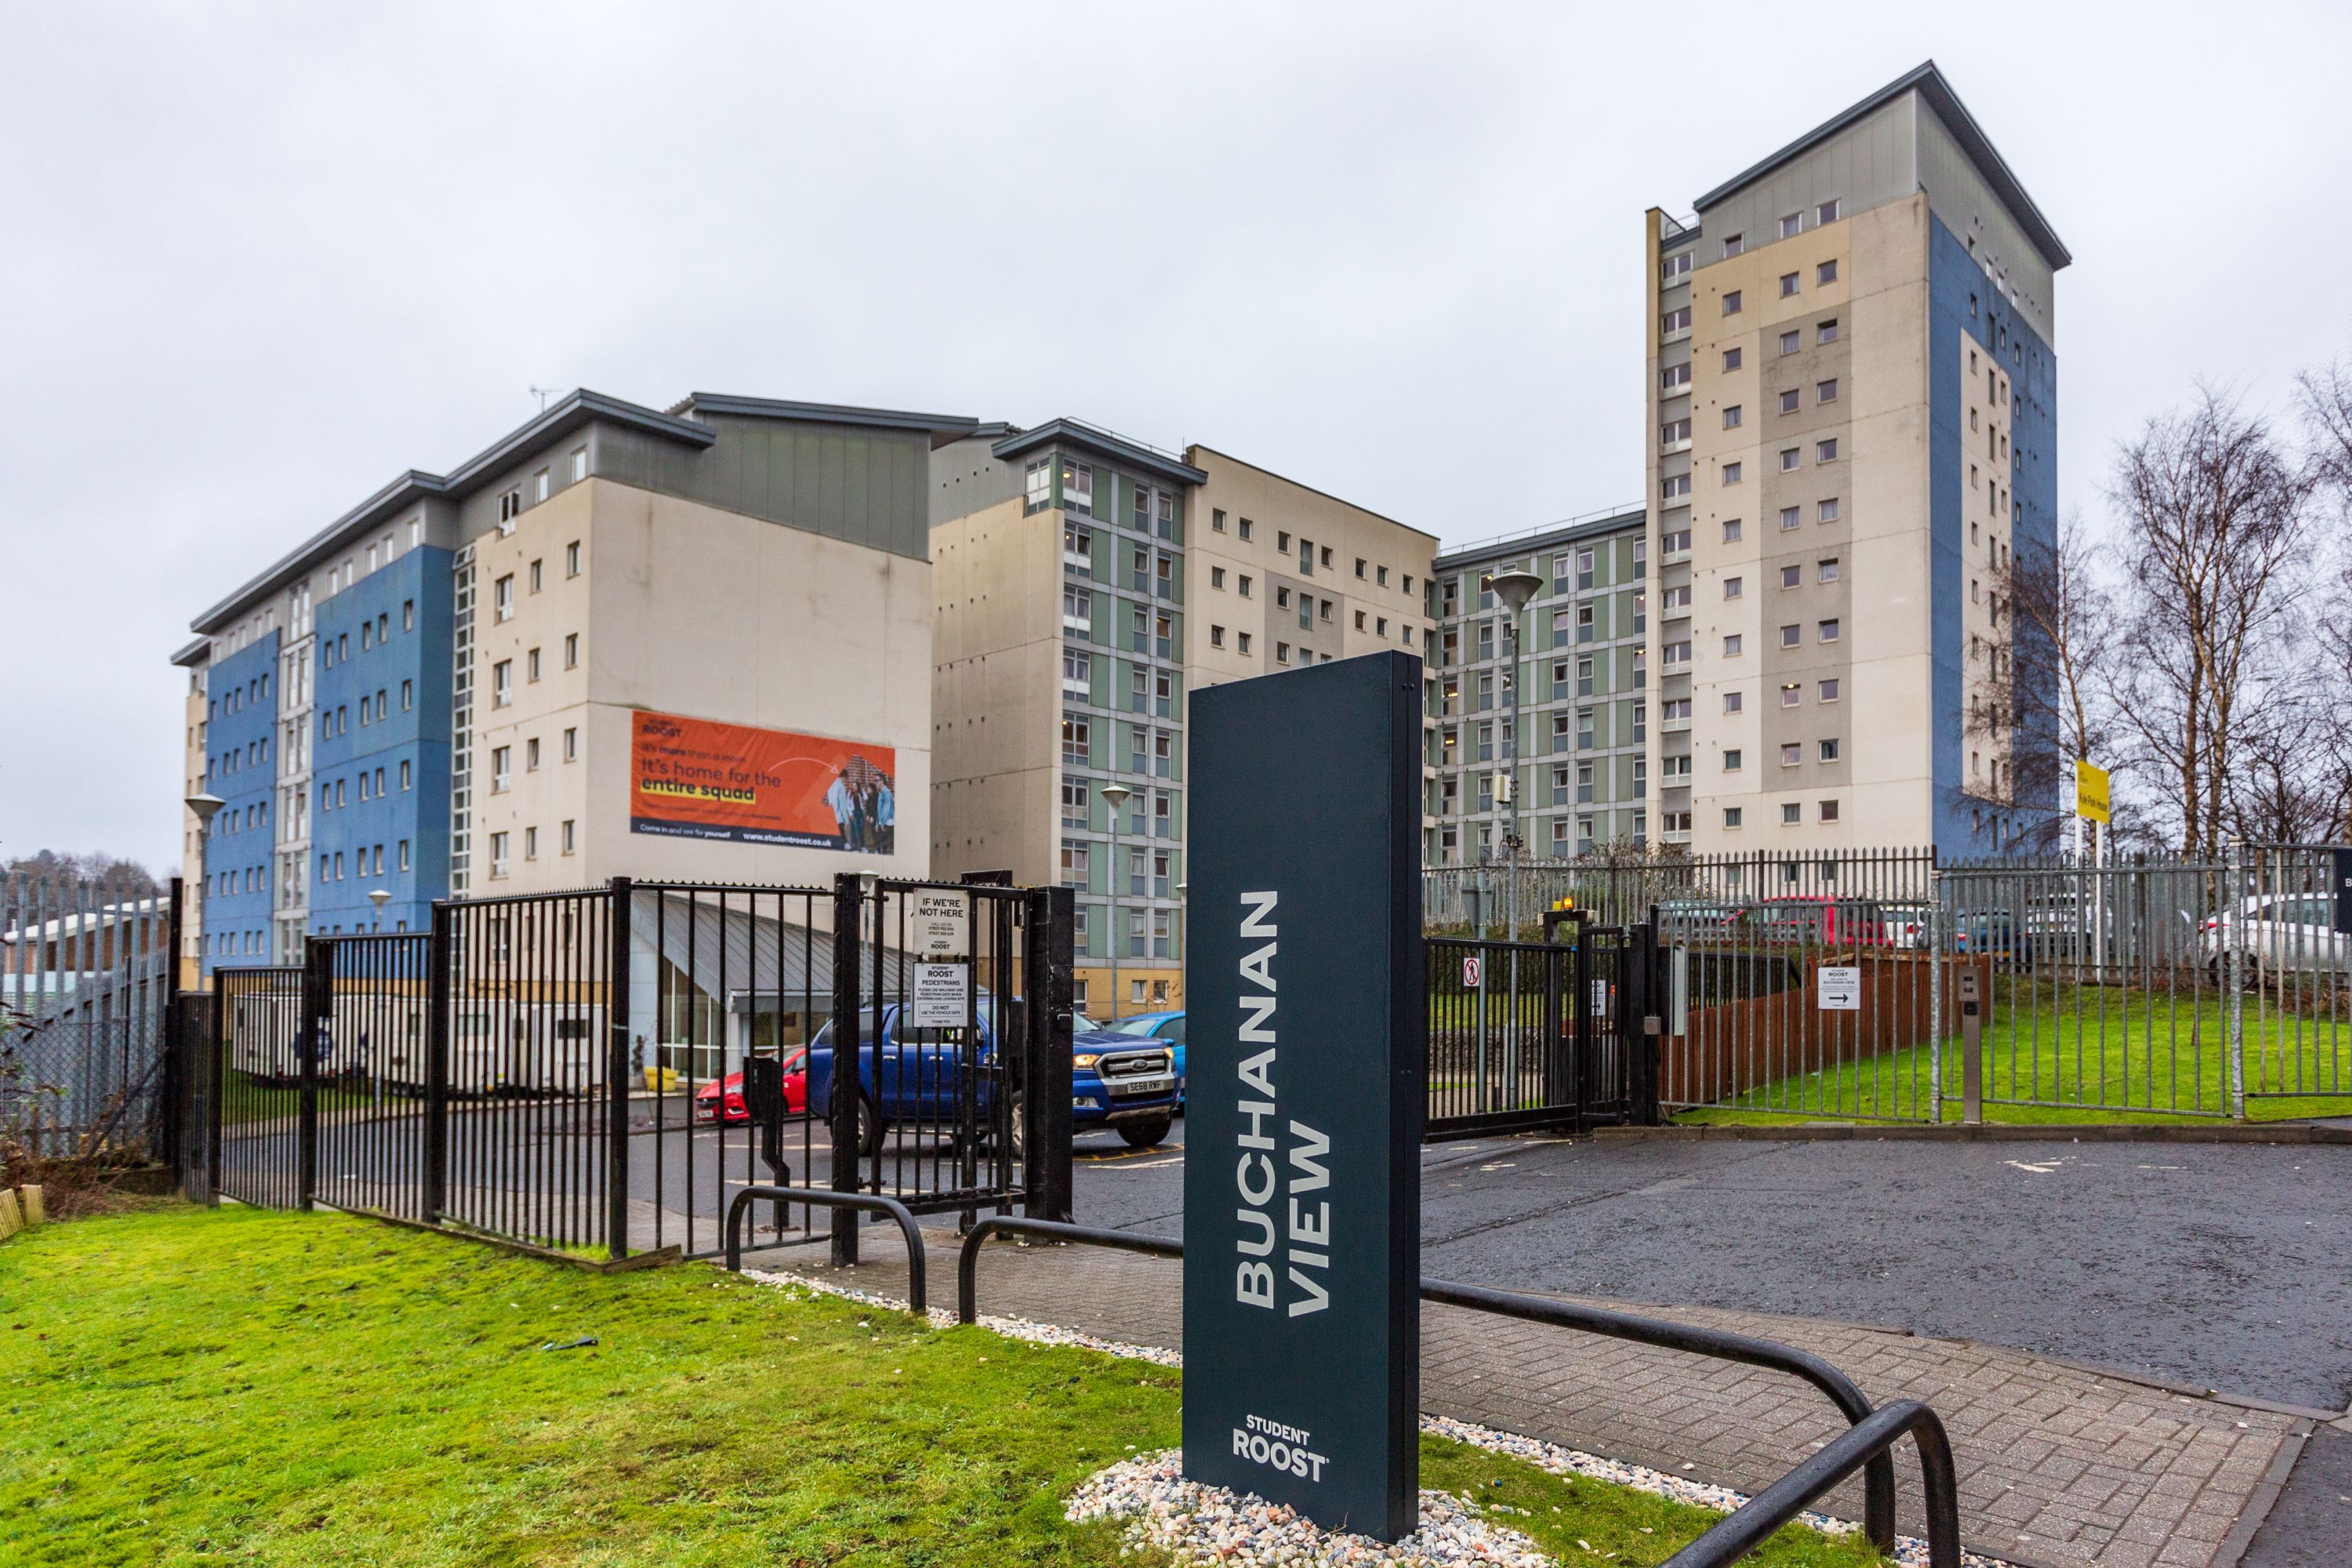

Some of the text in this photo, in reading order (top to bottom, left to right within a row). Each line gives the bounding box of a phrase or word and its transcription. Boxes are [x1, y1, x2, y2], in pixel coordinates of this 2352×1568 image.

[642, 724, 681, 737] ROOST
[641, 758, 782, 788] It's home for the
[642, 778, 754, 801] entire squad
[639, 823, 660, 833] Come
[743, 833, 832, 848] www.studentroost.co.uk
[920, 908, 938, 916] NOT
[933, 898, 960, 908] WE'RE
[1131, 1082, 1148, 1091] SE68
[1236, 891, 1277, 1309] BUCHANAN
[1289, 1120, 1330, 1317] VIEW
[1246, 1414, 1310, 1446] STUDENT
[1233, 1428, 1326, 1483] ROOST
